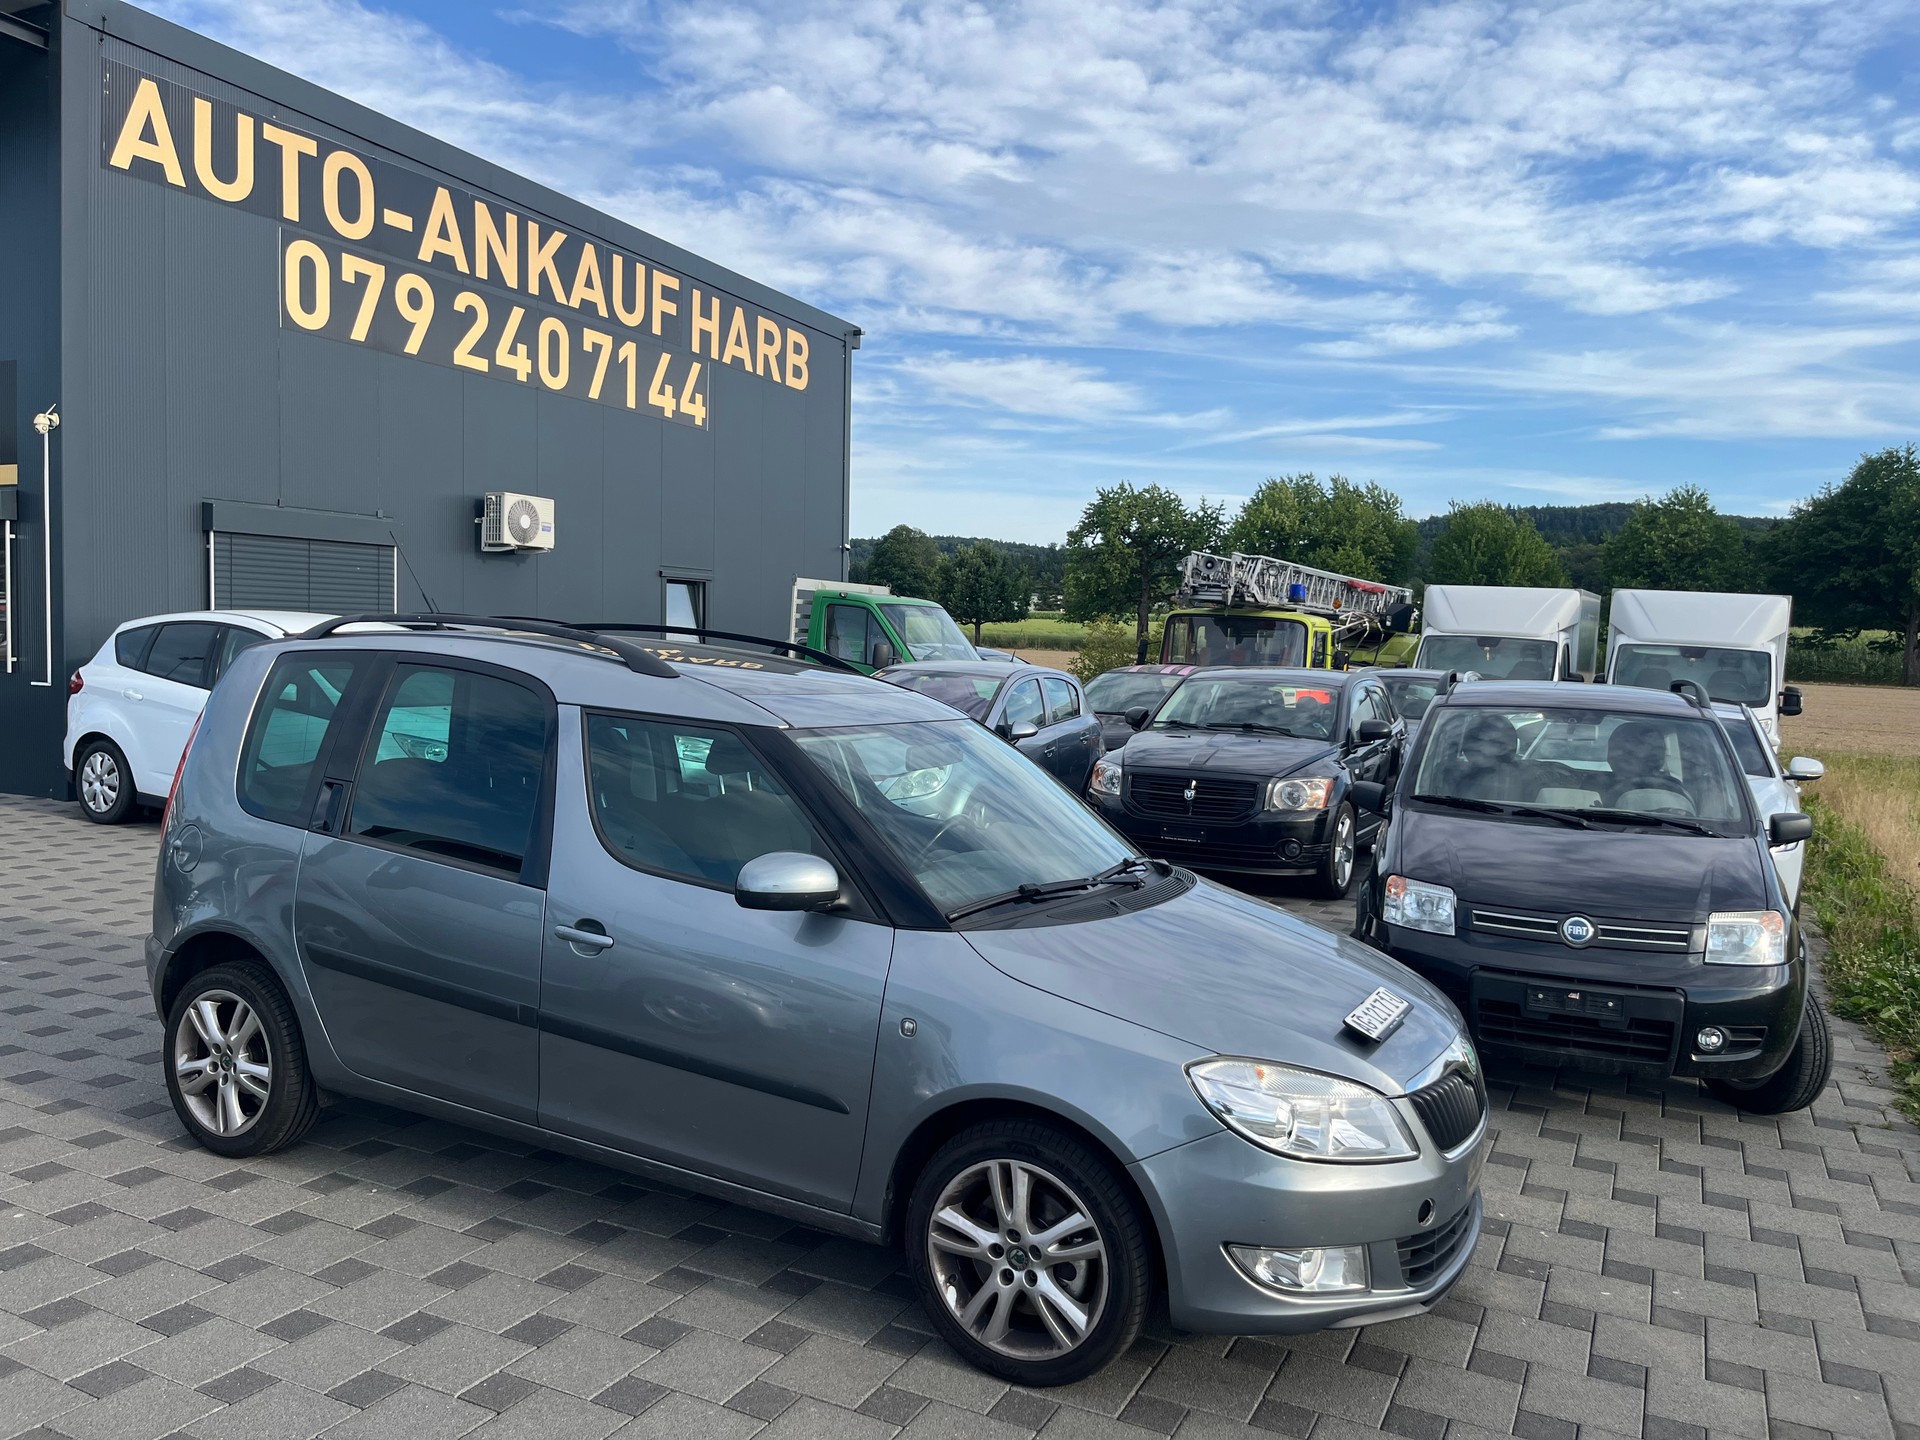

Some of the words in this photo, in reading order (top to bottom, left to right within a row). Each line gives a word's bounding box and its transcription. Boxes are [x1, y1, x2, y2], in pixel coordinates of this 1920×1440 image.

[110, 78, 681, 336] AUTO-ANKAUF
[691, 289, 810, 391] HARB
[284, 239, 435, 355] 079
[453, 291, 570, 391] 240
[1567, 925, 1588, 936] FIAT
